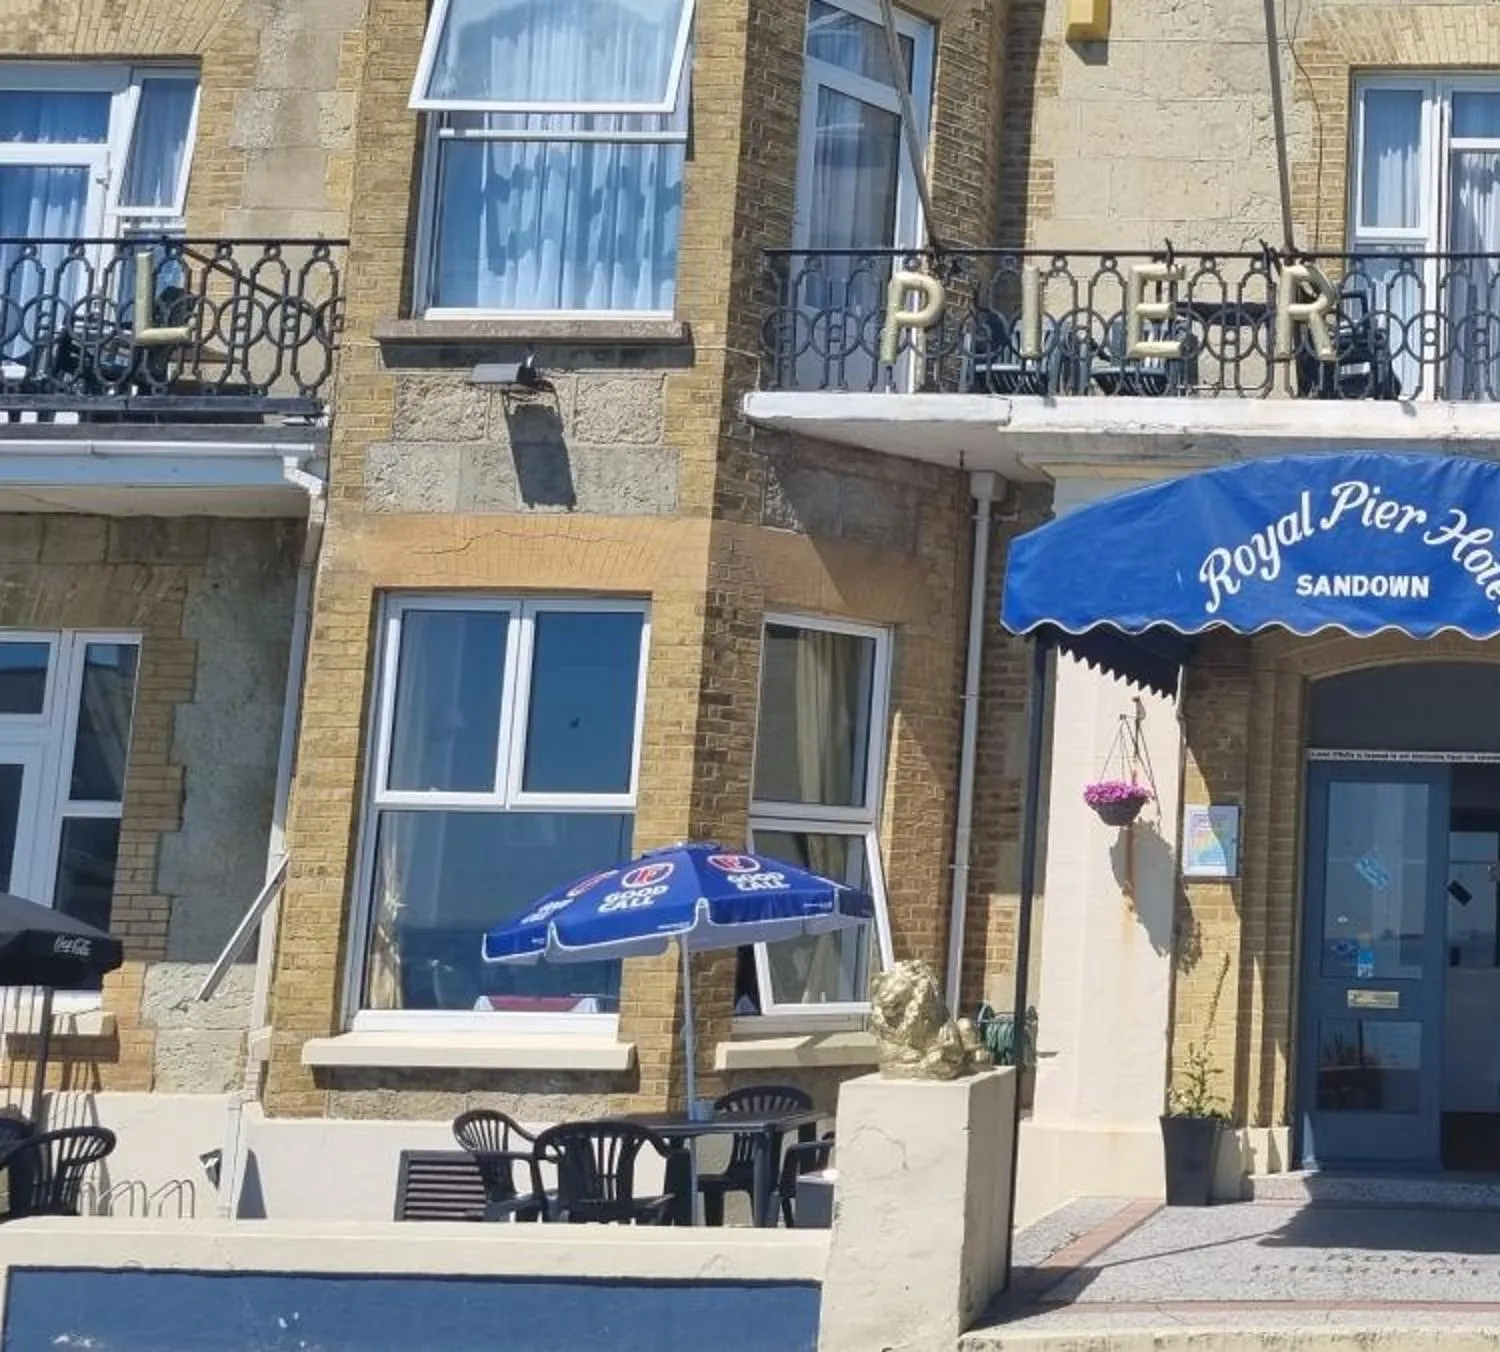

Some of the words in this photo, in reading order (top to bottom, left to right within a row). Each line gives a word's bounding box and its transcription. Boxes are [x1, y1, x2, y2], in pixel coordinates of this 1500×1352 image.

[880, 263, 1339, 365] PIER
[1199, 491, 1315, 613] Royal
[1320, 480, 1427, 533] Pier
[1296, 574, 1430, 598] SANDOWN
[597, 895, 656, 912] CALL
[604, 884, 669, 903] GOOD
